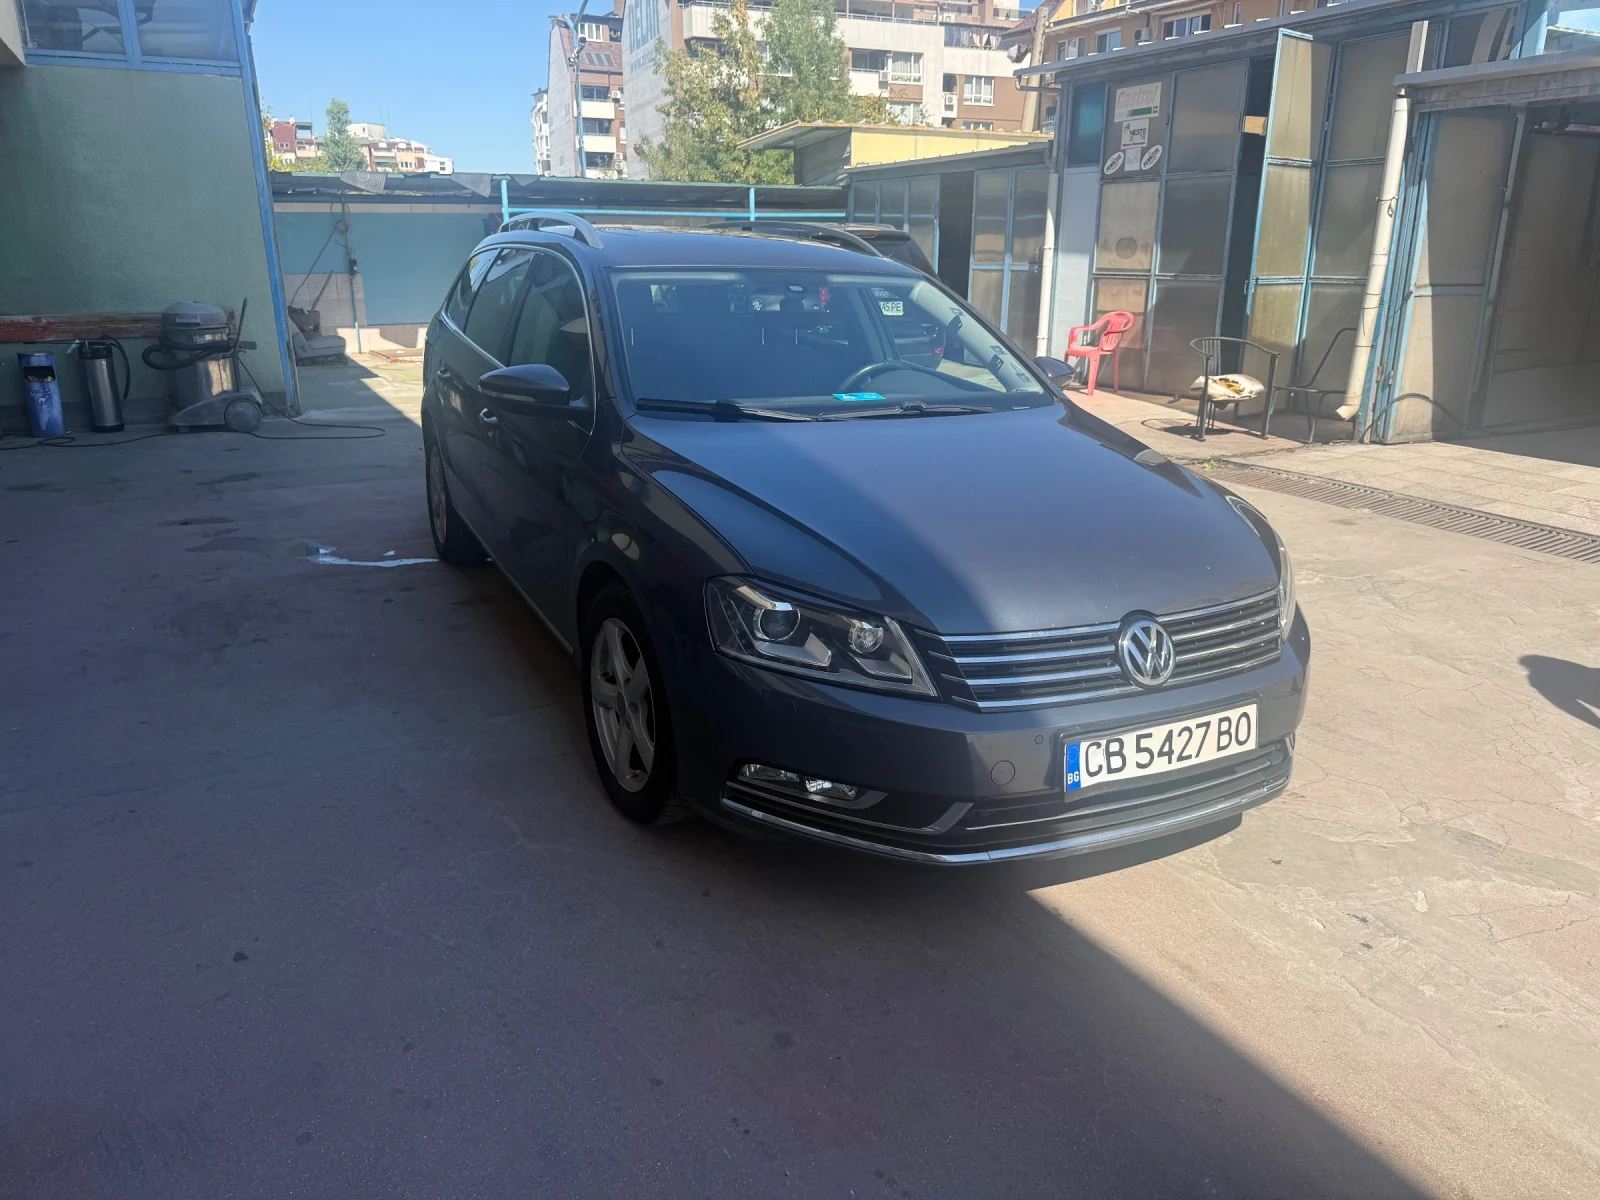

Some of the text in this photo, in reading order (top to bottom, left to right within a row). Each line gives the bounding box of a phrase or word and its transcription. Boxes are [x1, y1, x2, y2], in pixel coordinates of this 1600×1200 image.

[1117, 85, 1159, 107] Castrol
[1129, 128, 1147, 136] NESTE
[880, 302, 902, 312] 45 PE
[1085, 711, 1252, 778] CB 5427 BO
[1067, 771, 1080, 785] BG
